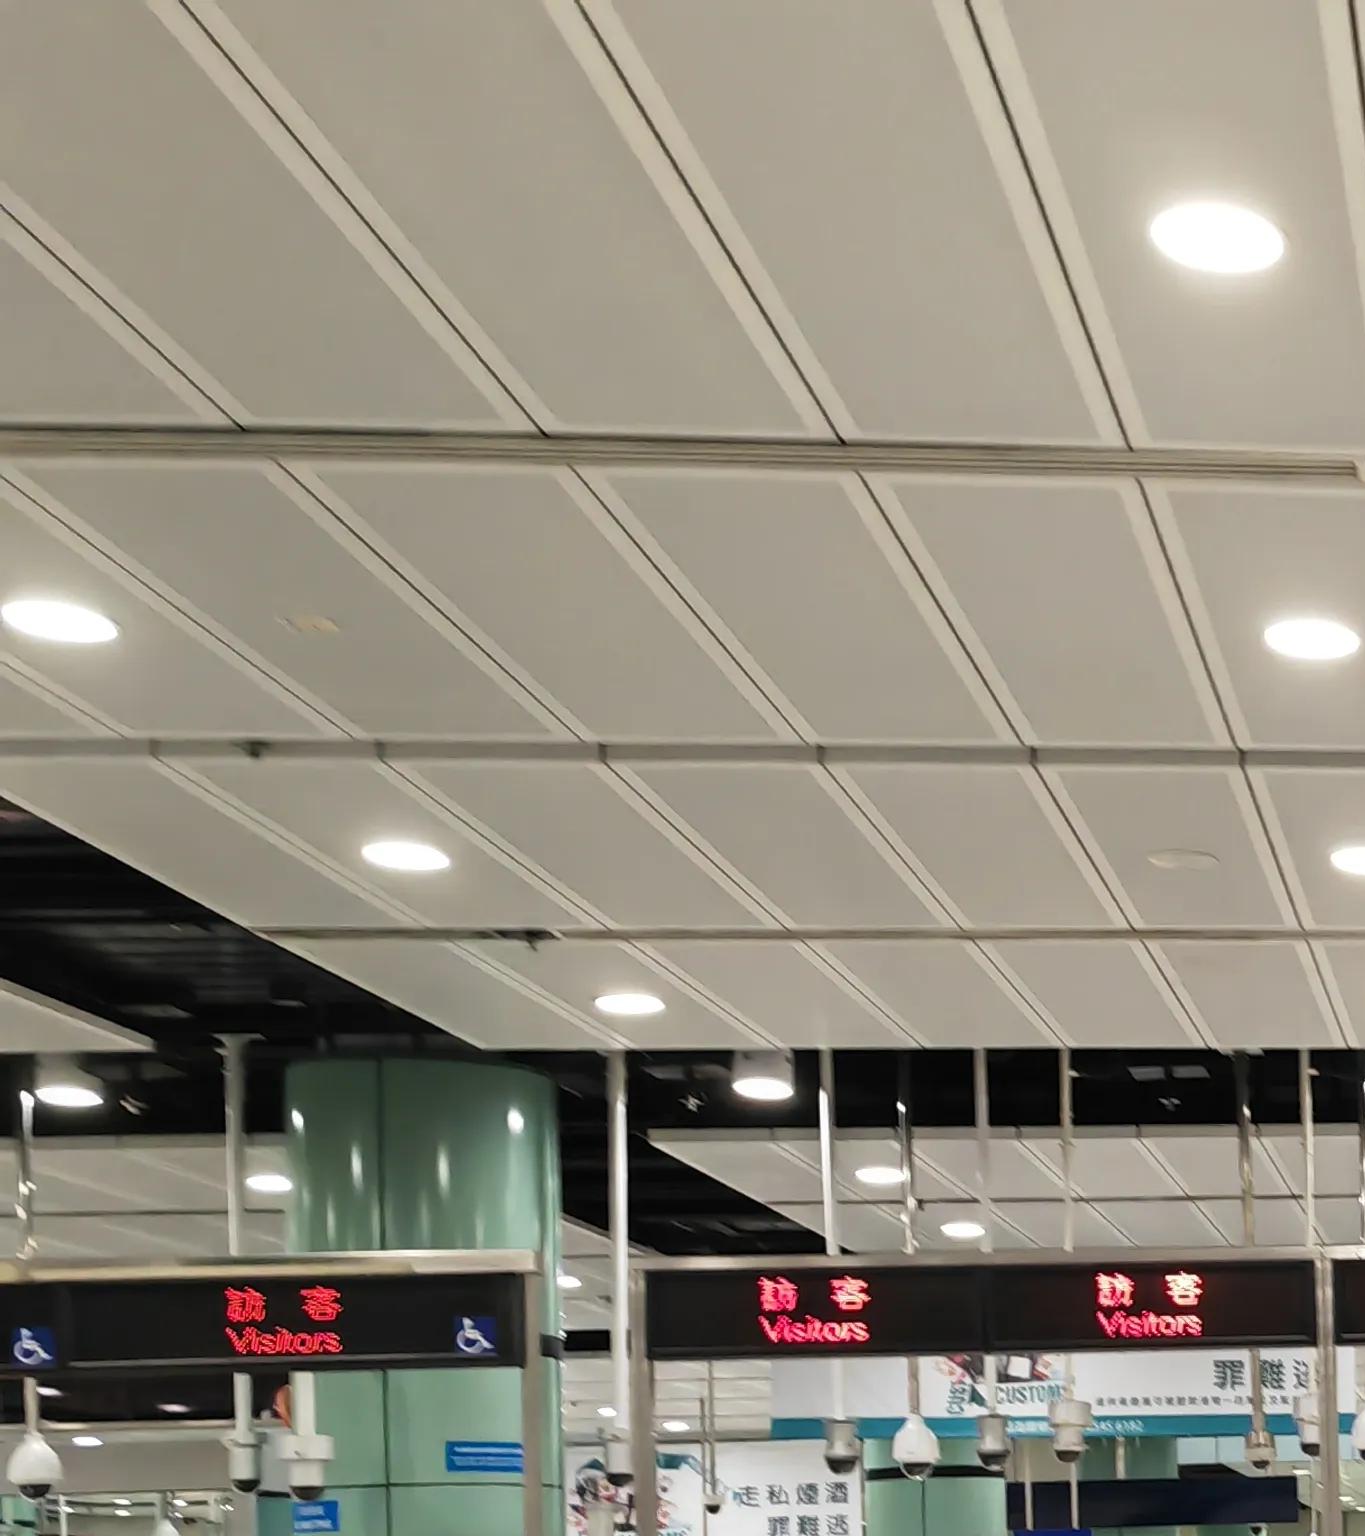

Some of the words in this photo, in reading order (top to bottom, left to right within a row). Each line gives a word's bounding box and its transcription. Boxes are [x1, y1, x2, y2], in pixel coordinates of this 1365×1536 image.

[225, 1286, 343, 1322] 訪客
[757, 1276, 871, 1312] 訪客
[1095, 1273, 1203, 1307] 訪客
[758, 1315, 870, 1343] Visitors
[1096, 1311, 1202, 1338] Visitors
[225, 1327, 343, 1354] Visitors
